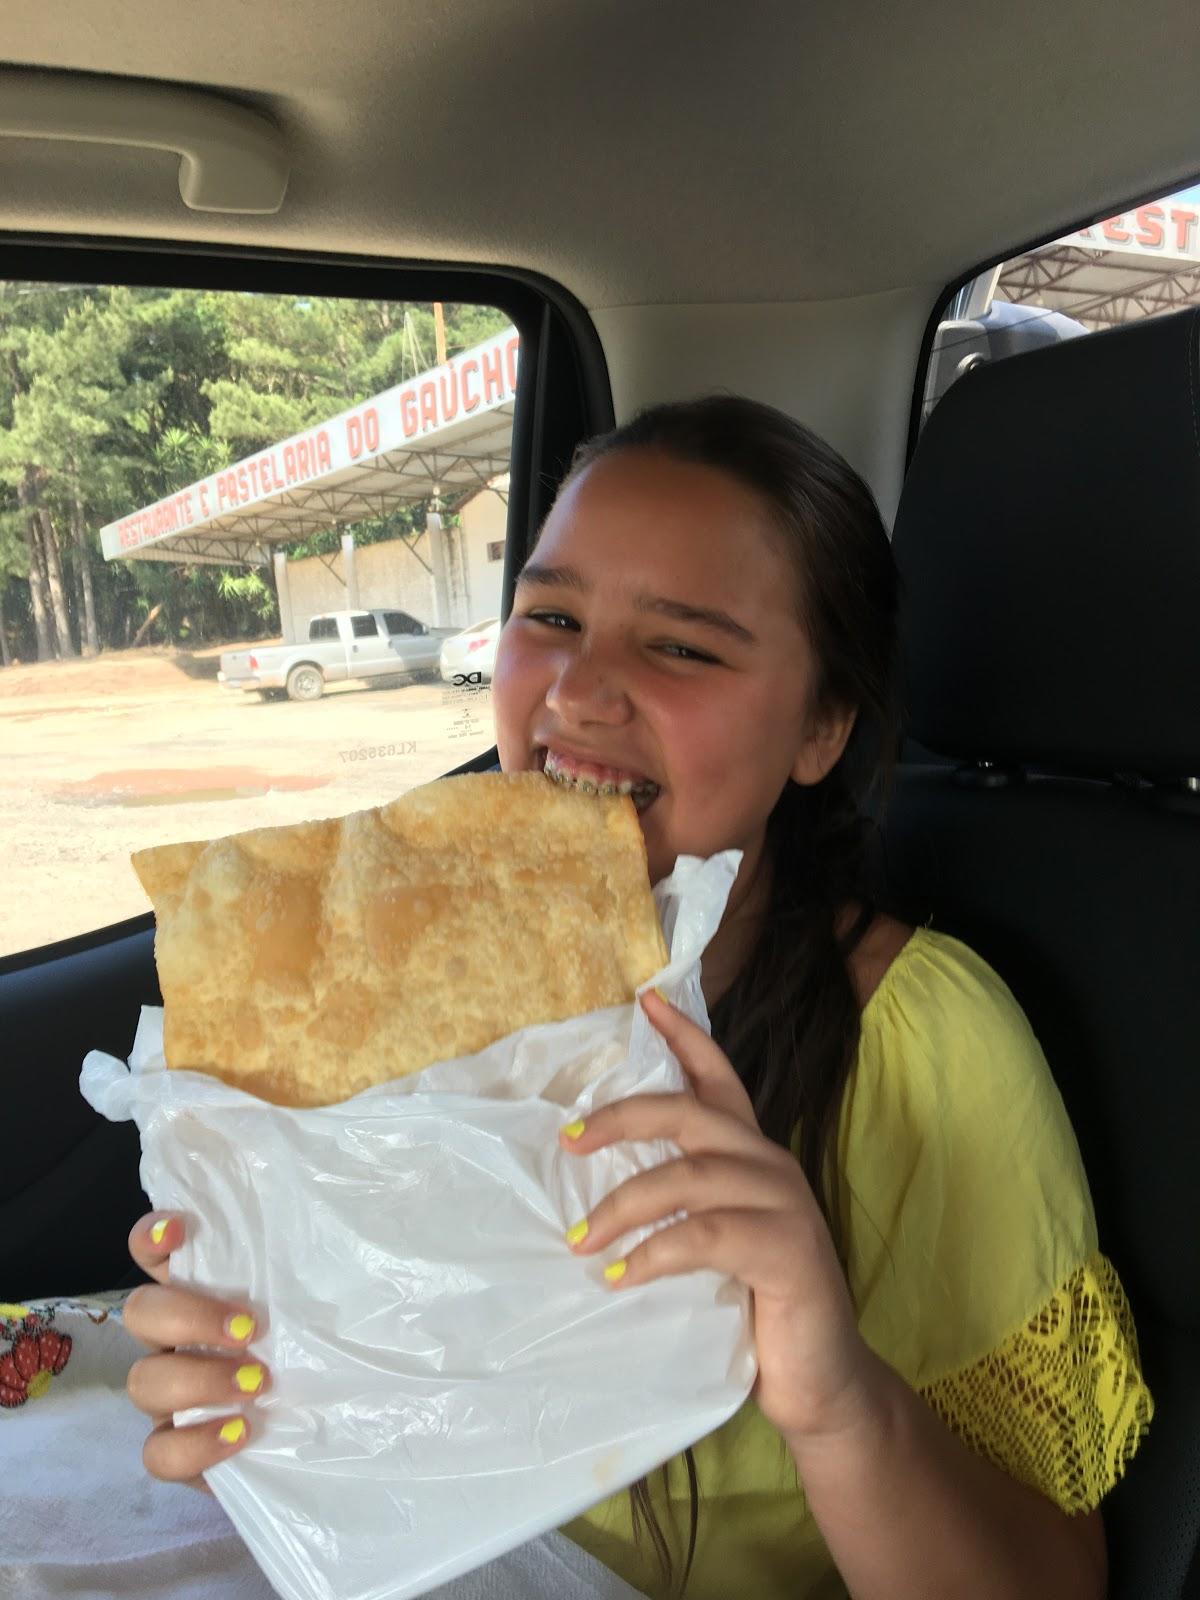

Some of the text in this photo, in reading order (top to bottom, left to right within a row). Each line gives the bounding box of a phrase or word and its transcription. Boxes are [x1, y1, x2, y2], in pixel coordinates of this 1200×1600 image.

[1079, 204, 1199, 252] EST
[199, 483, 209, 517] E
[216, 431, 332, 510] PASTELARIA
[346, 406, 379, 459] DO
